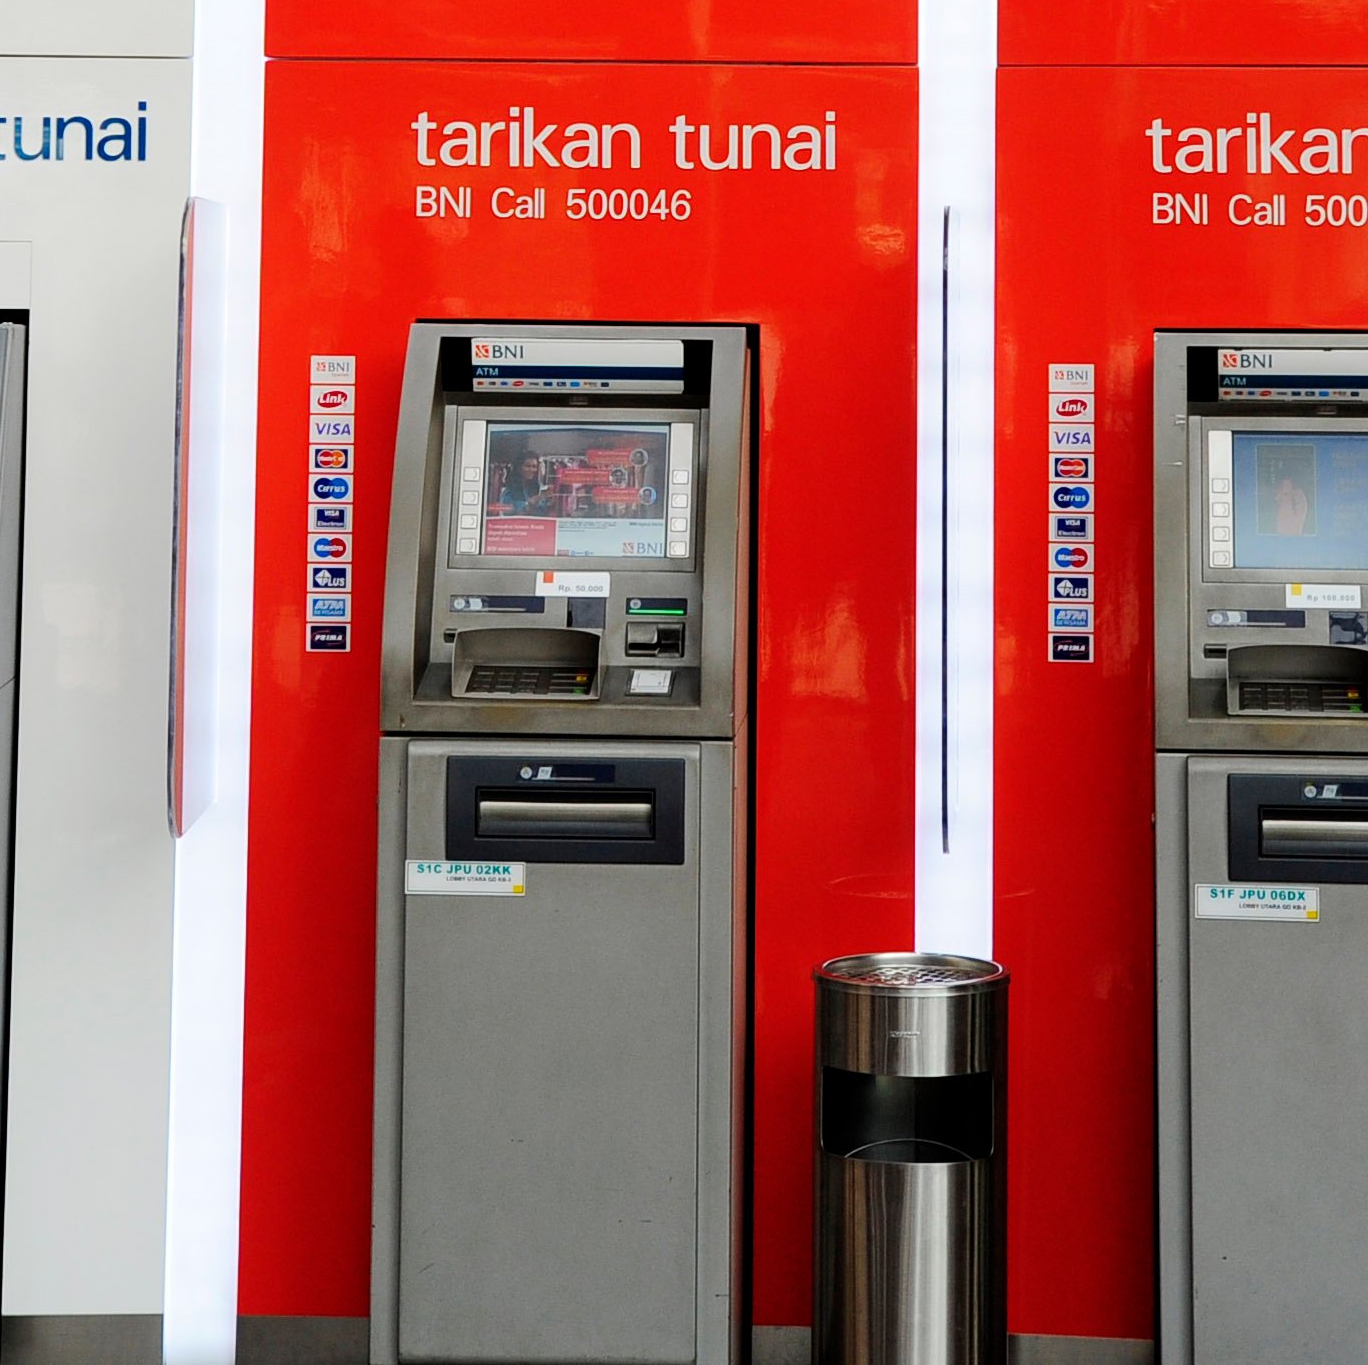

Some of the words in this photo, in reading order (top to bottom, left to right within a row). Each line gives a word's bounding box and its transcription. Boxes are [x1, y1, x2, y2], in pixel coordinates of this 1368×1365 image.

[411, 107, 641, 169] tarikan
[668, 111, 836, 171] tunai
[414, 186, 471, 219] BNI
[490, 188, 545, 220] Call
[566, 189, 692, 220] 500046
[1151, 192, 1209, 225] BNI
[1228, 194, 1286, 226] Call
[492, 345, 524, 359] BNI
[329, 362, 349, 371] BNI
[1240, 354, 1273, 368] BNI
[476, 367, 499, 376] ATM
[1067, 371, 1088, 380] BNI
[1223, 377, 1246, 385] ATM
[315, 423, 351, 435] VISA
[1054, 431, 1091, 444] VISA
[637, 543, 663, 555] BNI
[417, 864, 442, 874] S1C
[446, 864, 471, 875] JPU
[476, 865, 511, 875] 02KK
[1210, 888, 1234, 898] S1F
[1239, 889, 1265, 899] JPU
[1270, 890, 1305, 901] 06DX
